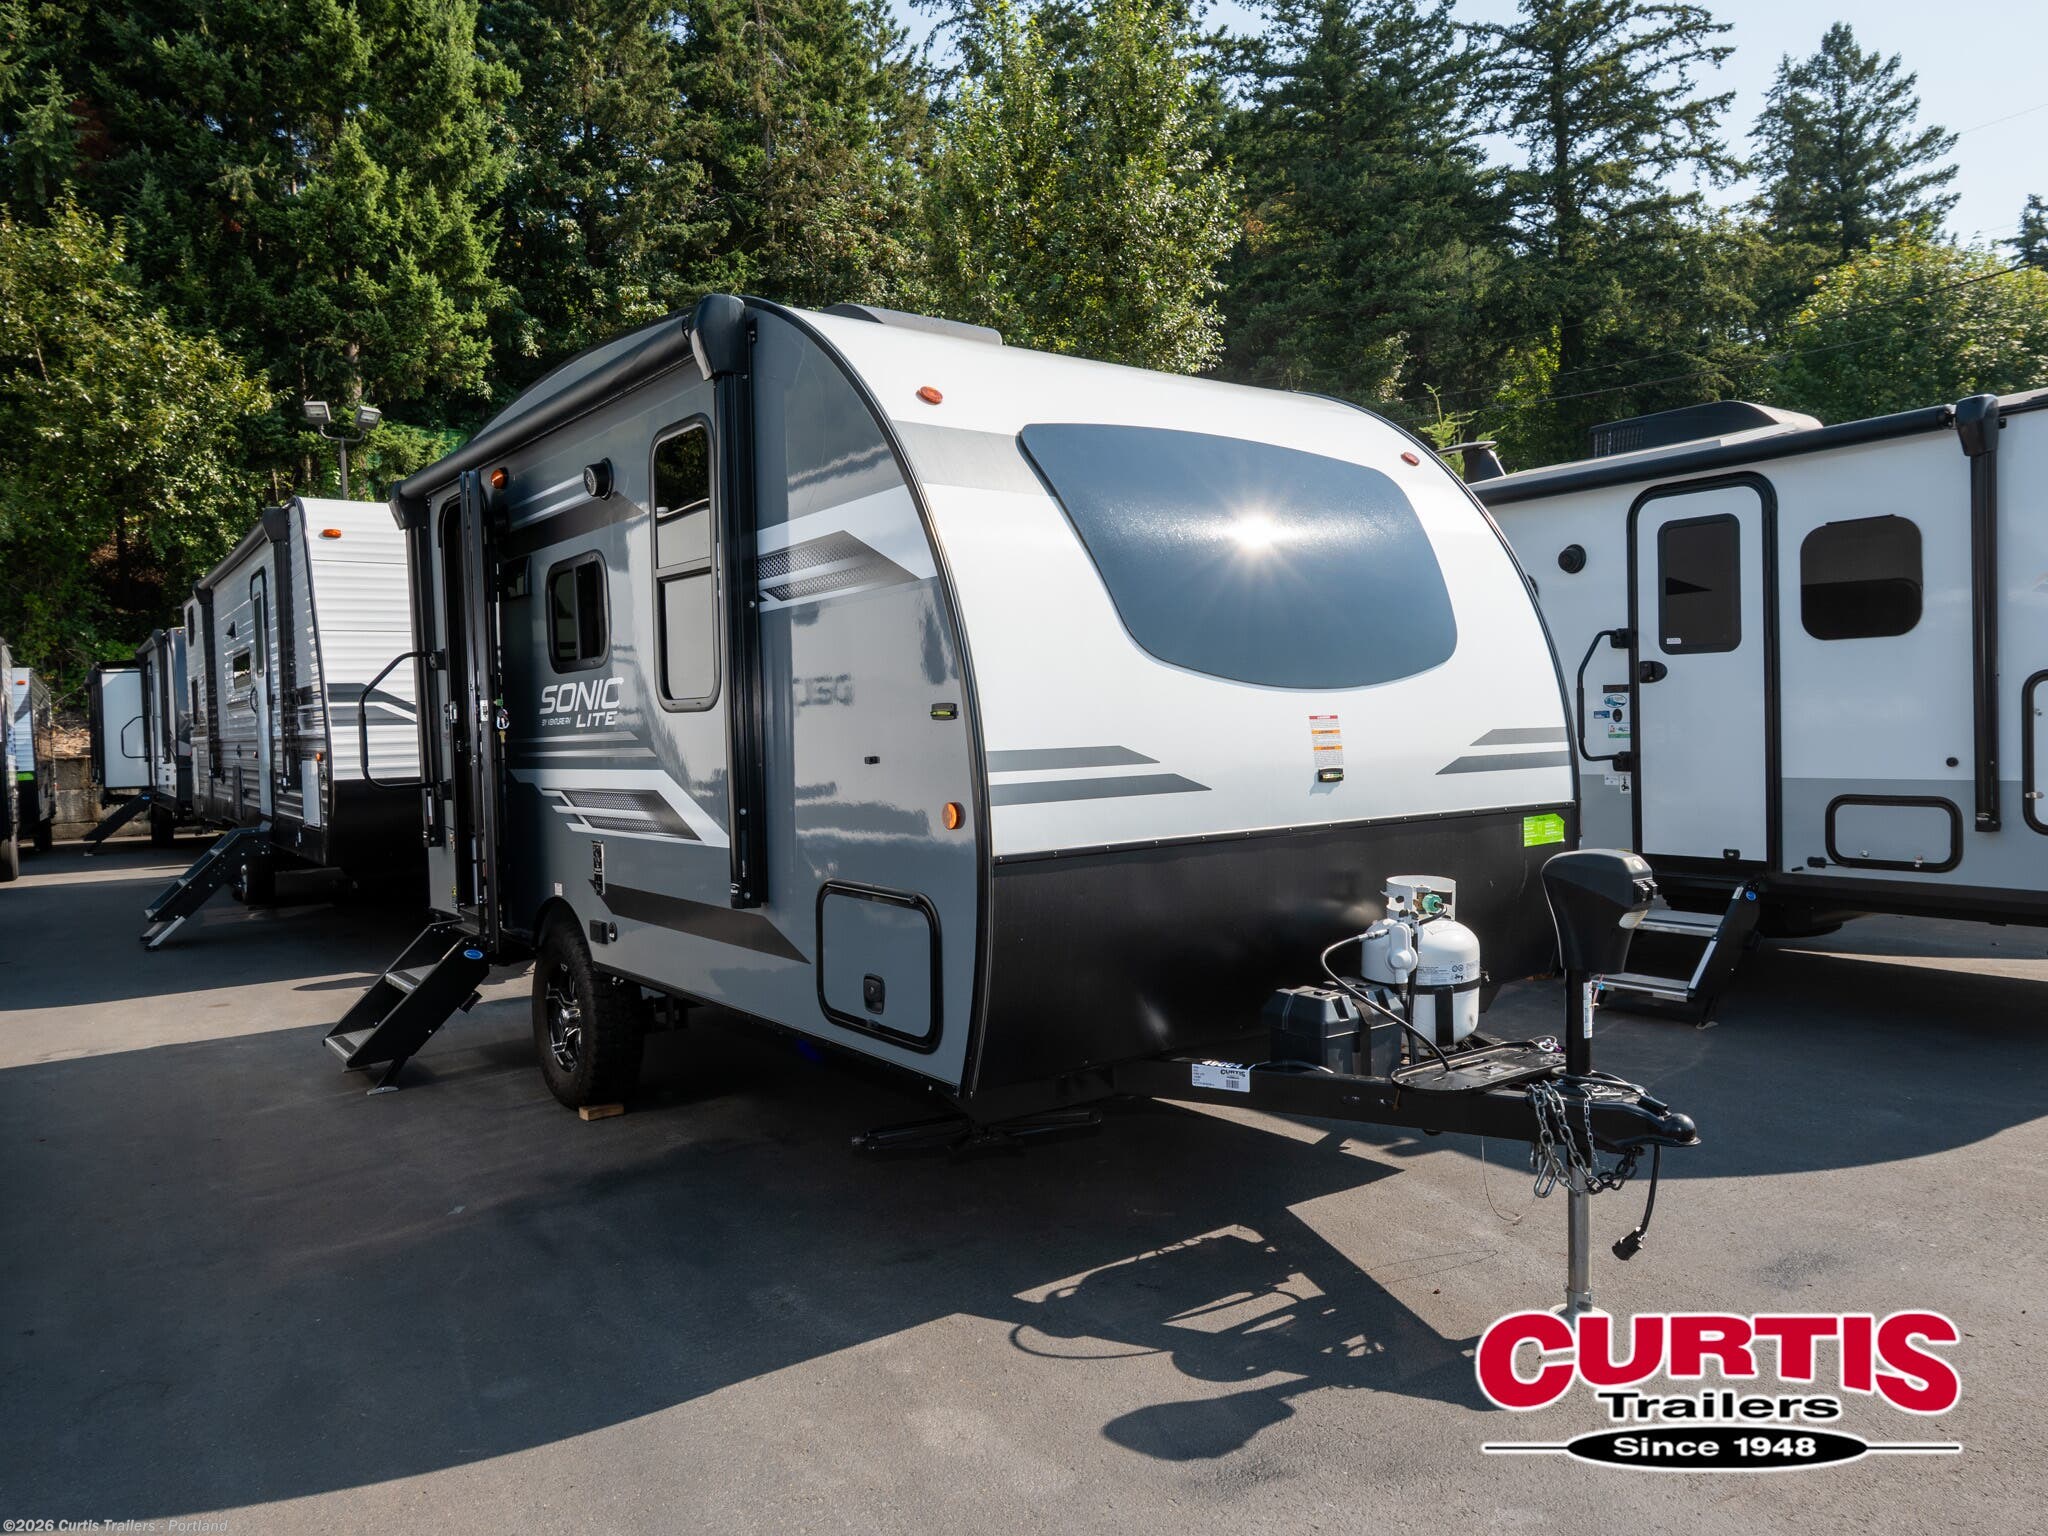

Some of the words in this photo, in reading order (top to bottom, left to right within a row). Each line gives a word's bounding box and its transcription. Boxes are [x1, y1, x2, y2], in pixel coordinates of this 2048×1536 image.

[539, 677, 624, 714] SONIC
[576, 711, 618, 728] LITE
[1220, 1069, 1246, 1077] CURTIS
